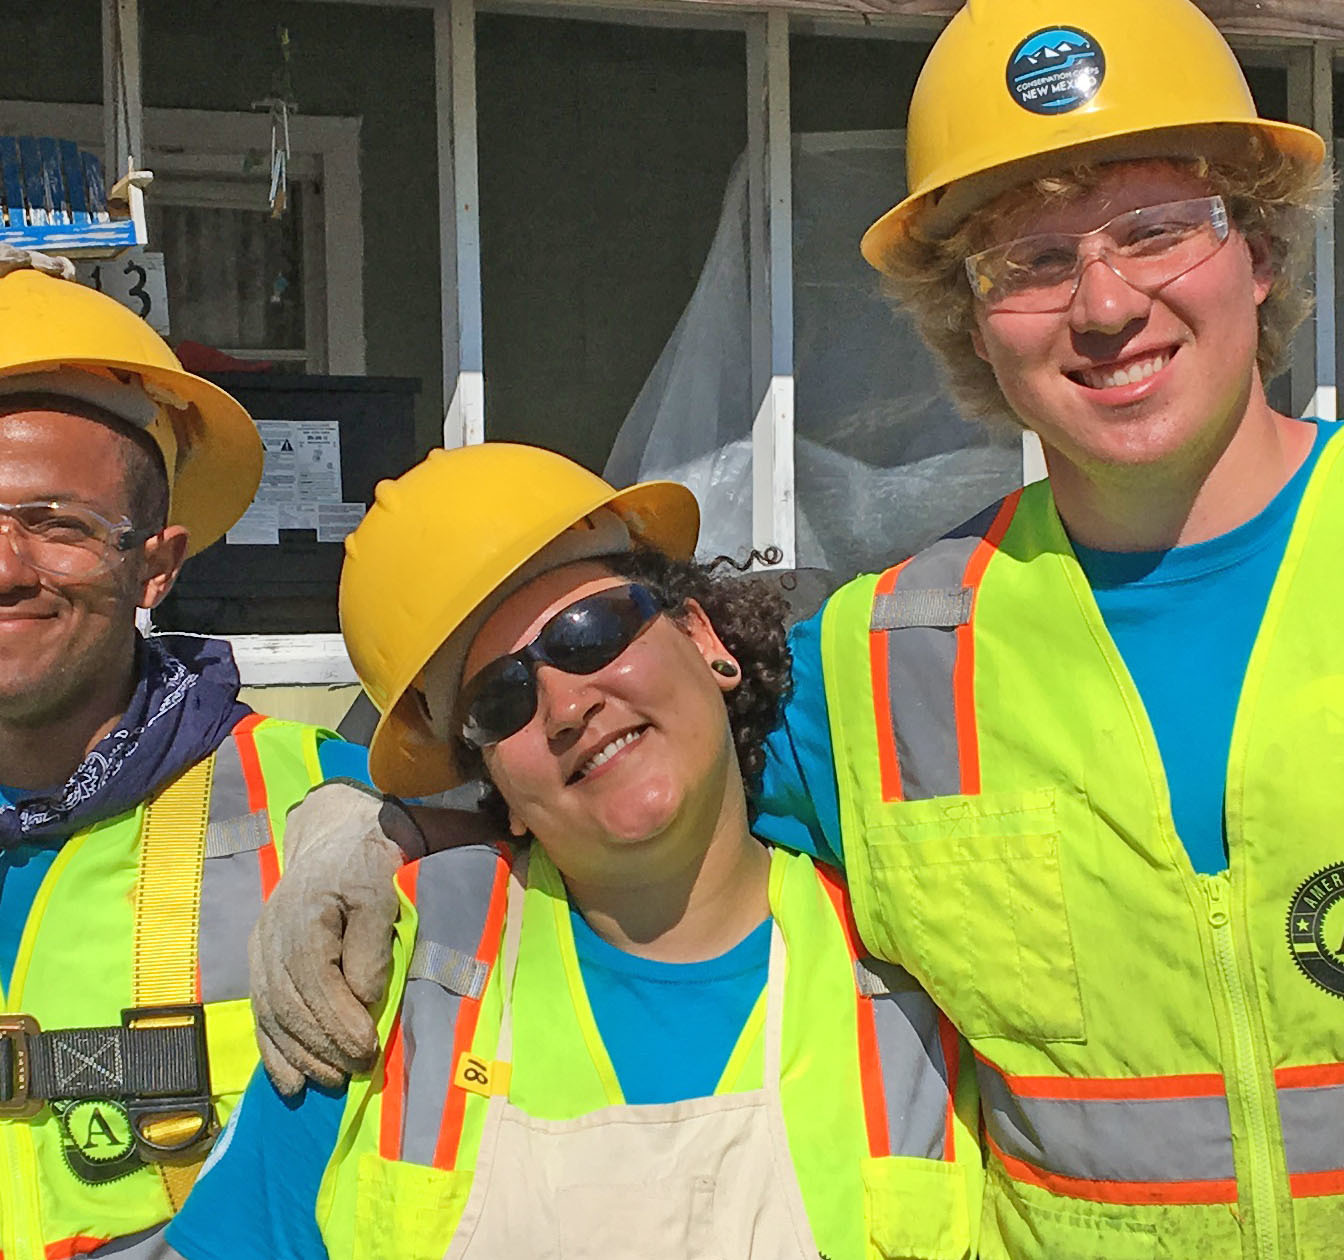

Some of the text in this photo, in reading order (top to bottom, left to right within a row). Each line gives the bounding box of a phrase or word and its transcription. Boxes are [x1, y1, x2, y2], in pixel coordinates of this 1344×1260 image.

[1022, 76, 1097, 102] NEW MEXO
[81, 1107, 126, 1150] A
